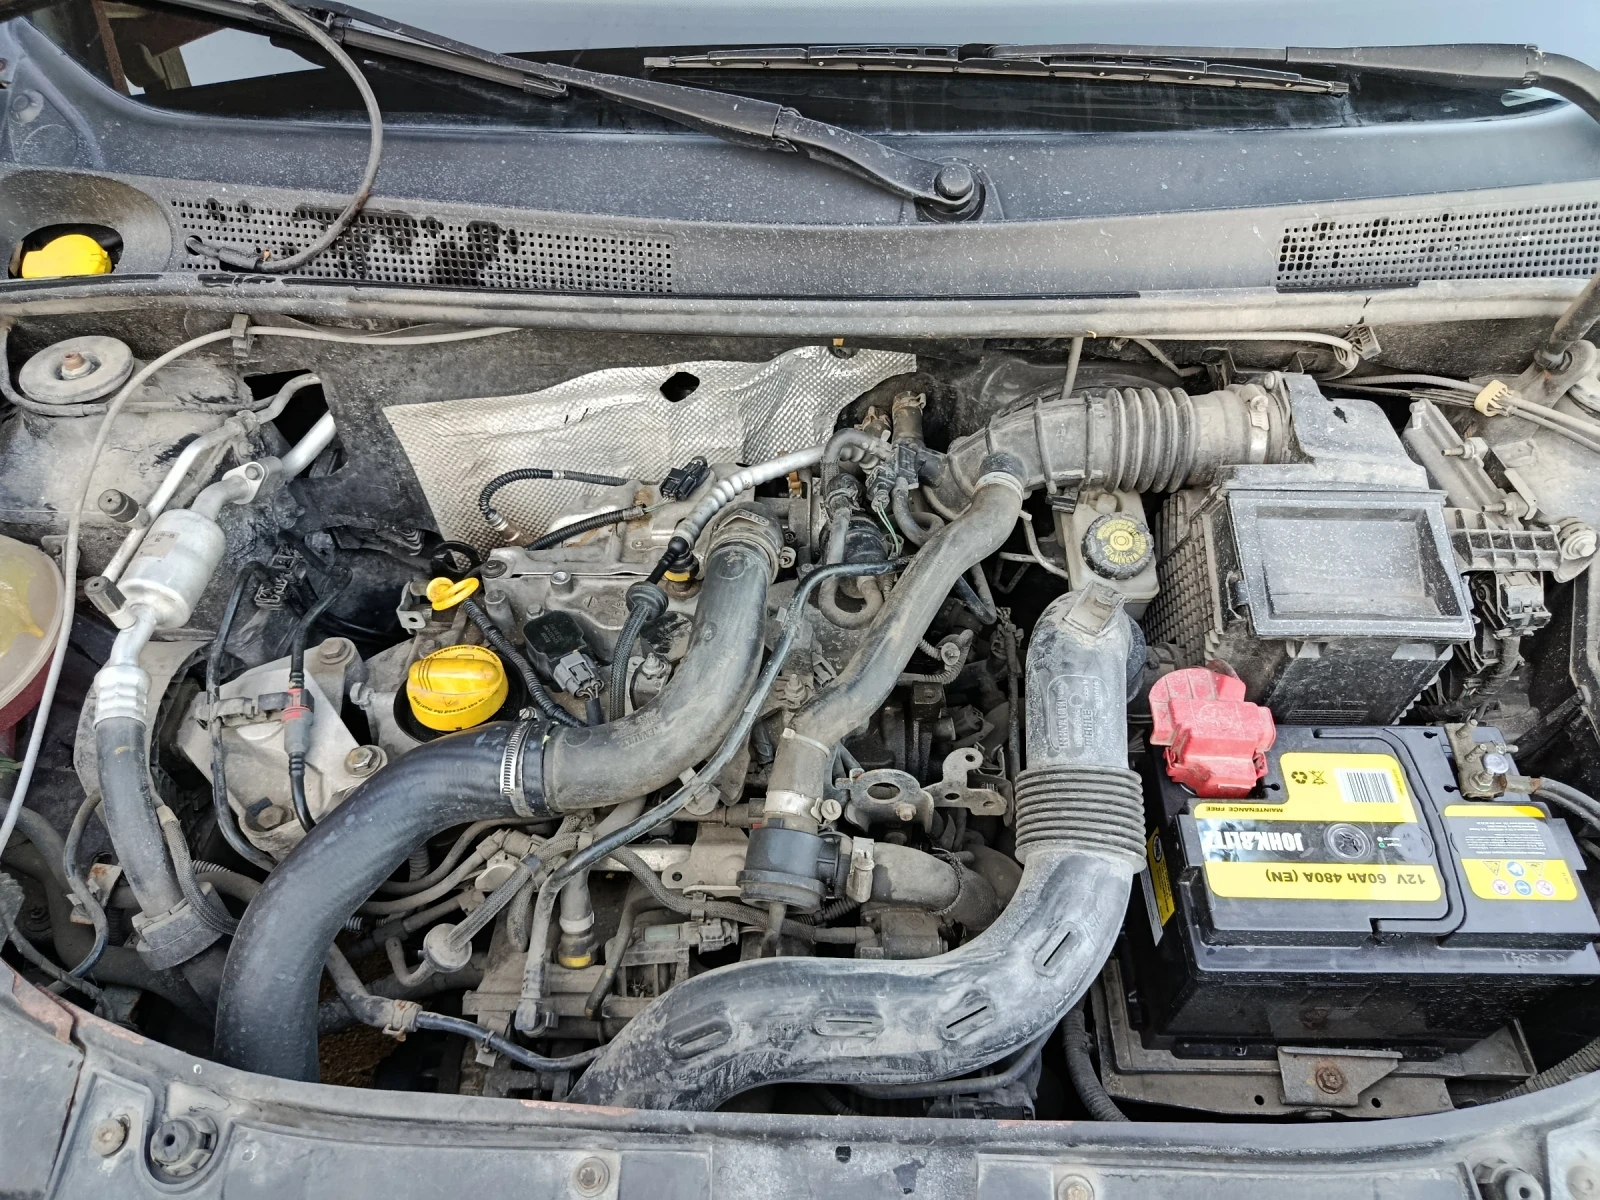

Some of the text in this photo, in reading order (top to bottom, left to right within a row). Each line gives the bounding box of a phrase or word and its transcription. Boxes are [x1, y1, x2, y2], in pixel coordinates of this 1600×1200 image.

[1083, 709, 1093, 747] MAHLE
[1266, 870, 1426, 884] 12V 60Ah 480A (EN)
